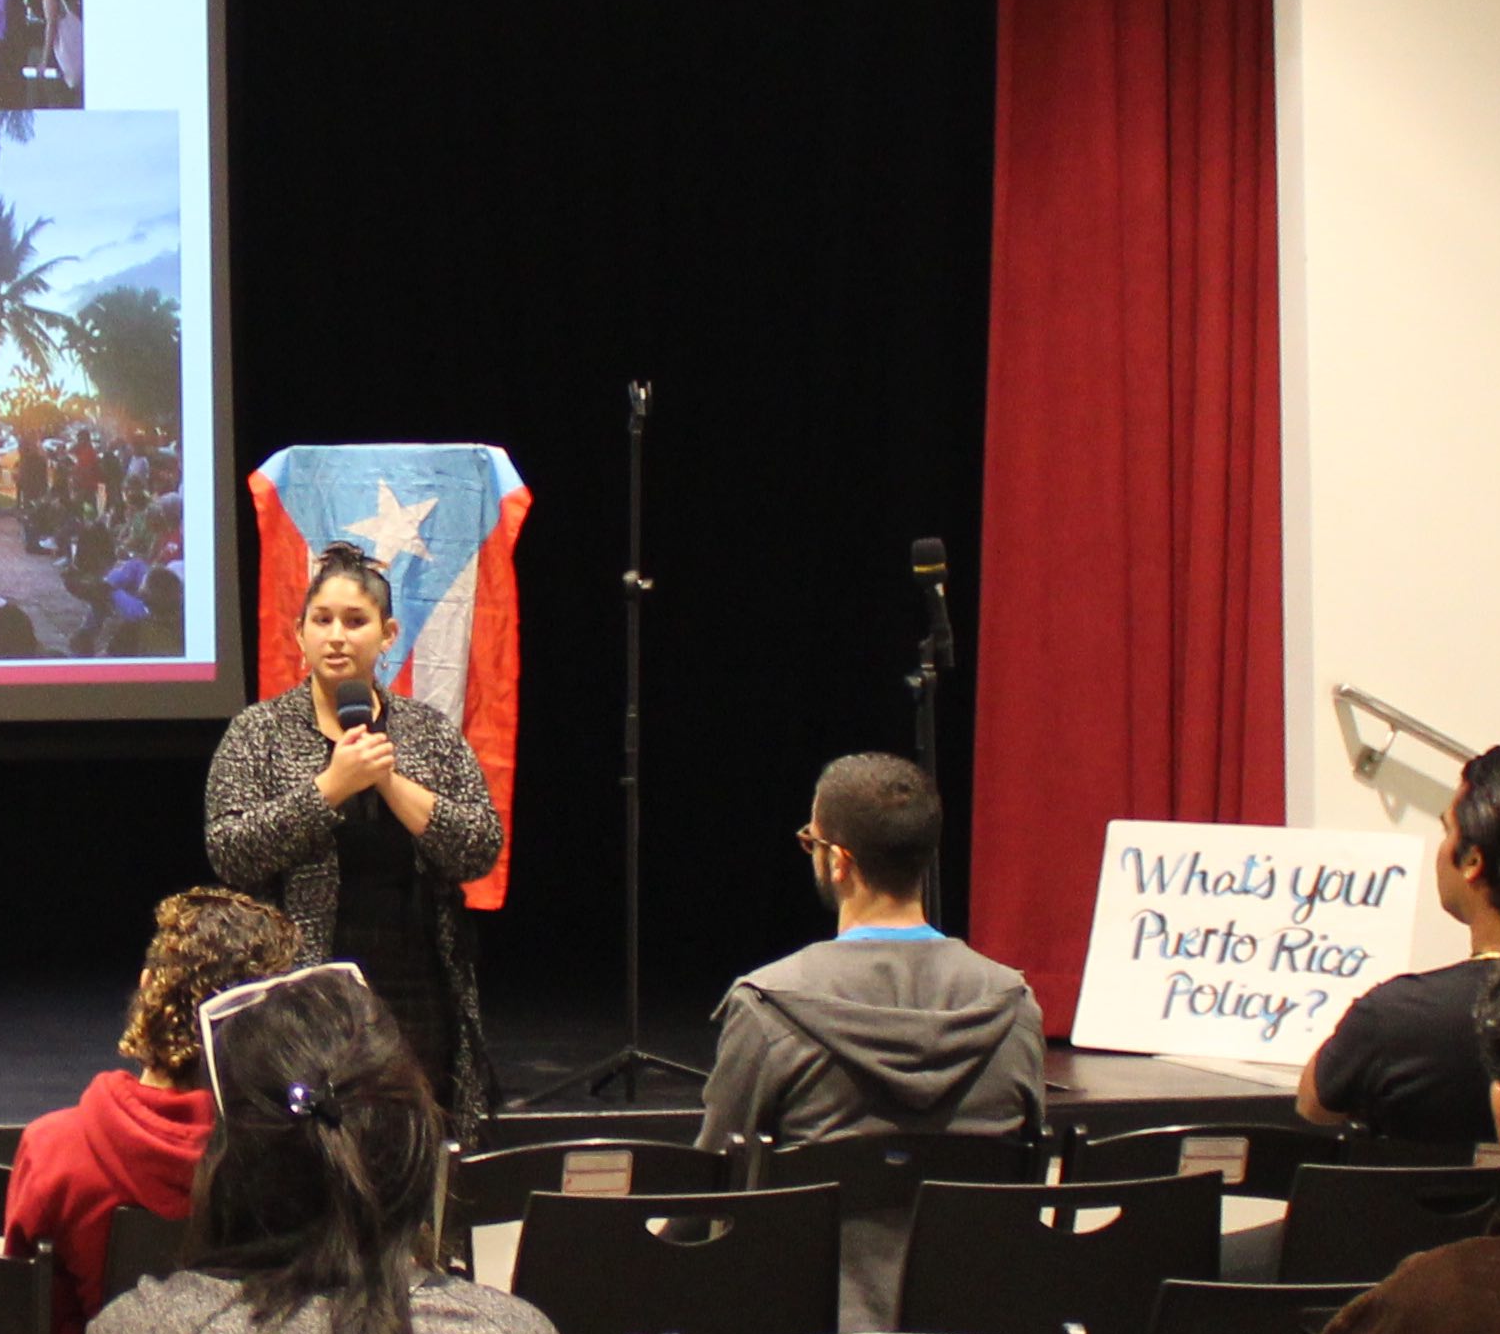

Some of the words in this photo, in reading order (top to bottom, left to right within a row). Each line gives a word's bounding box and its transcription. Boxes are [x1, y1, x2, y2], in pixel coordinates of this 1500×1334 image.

[1290, 864, 1407, 925] your
[1130, 908, 1258, 965] Puerto
[1268, 926, 1373, 978] Rico
